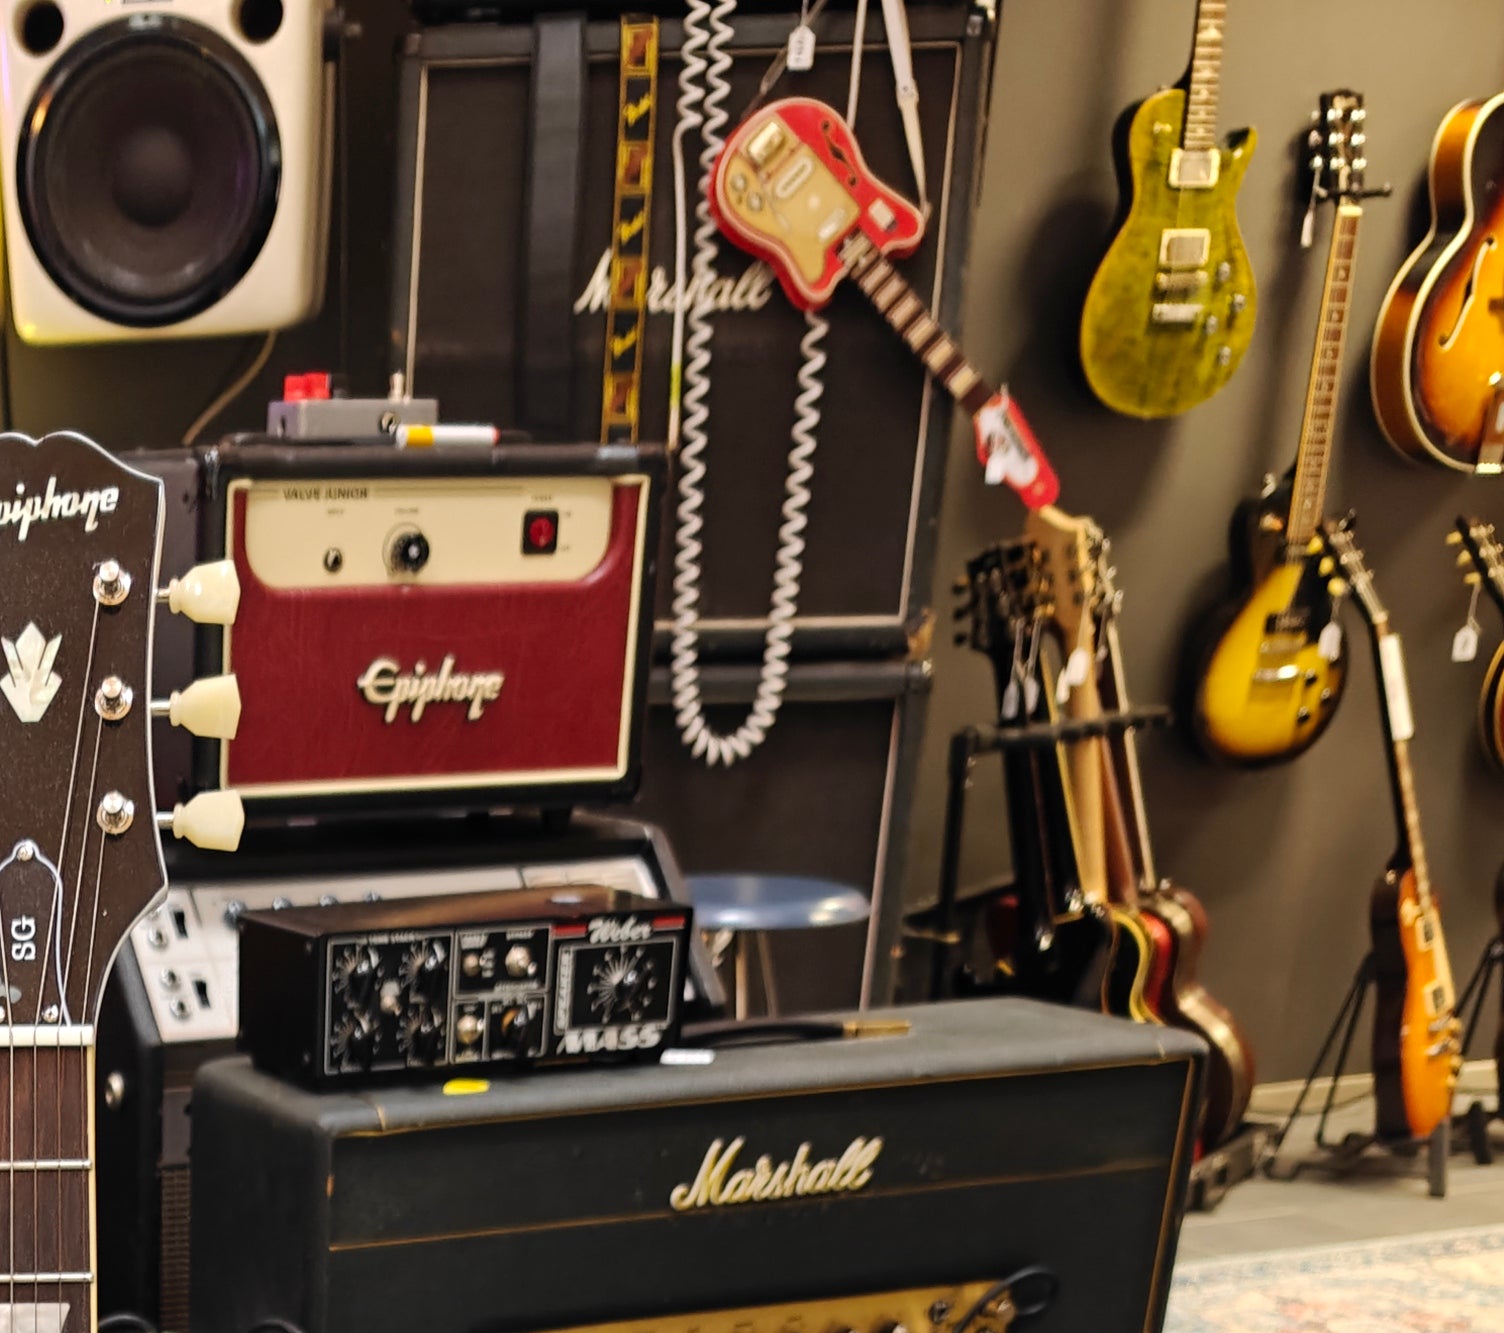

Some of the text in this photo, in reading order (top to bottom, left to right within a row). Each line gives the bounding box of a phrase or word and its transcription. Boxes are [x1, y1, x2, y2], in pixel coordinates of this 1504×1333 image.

[573, 247, 777, 315] Mrshall
[283, 487, 320, 500] VALVE
[356, 652, 505, 724] Epiphone
[10, 914, 36, 961] SG
[669, 1135, 885, 1212] Marshall
